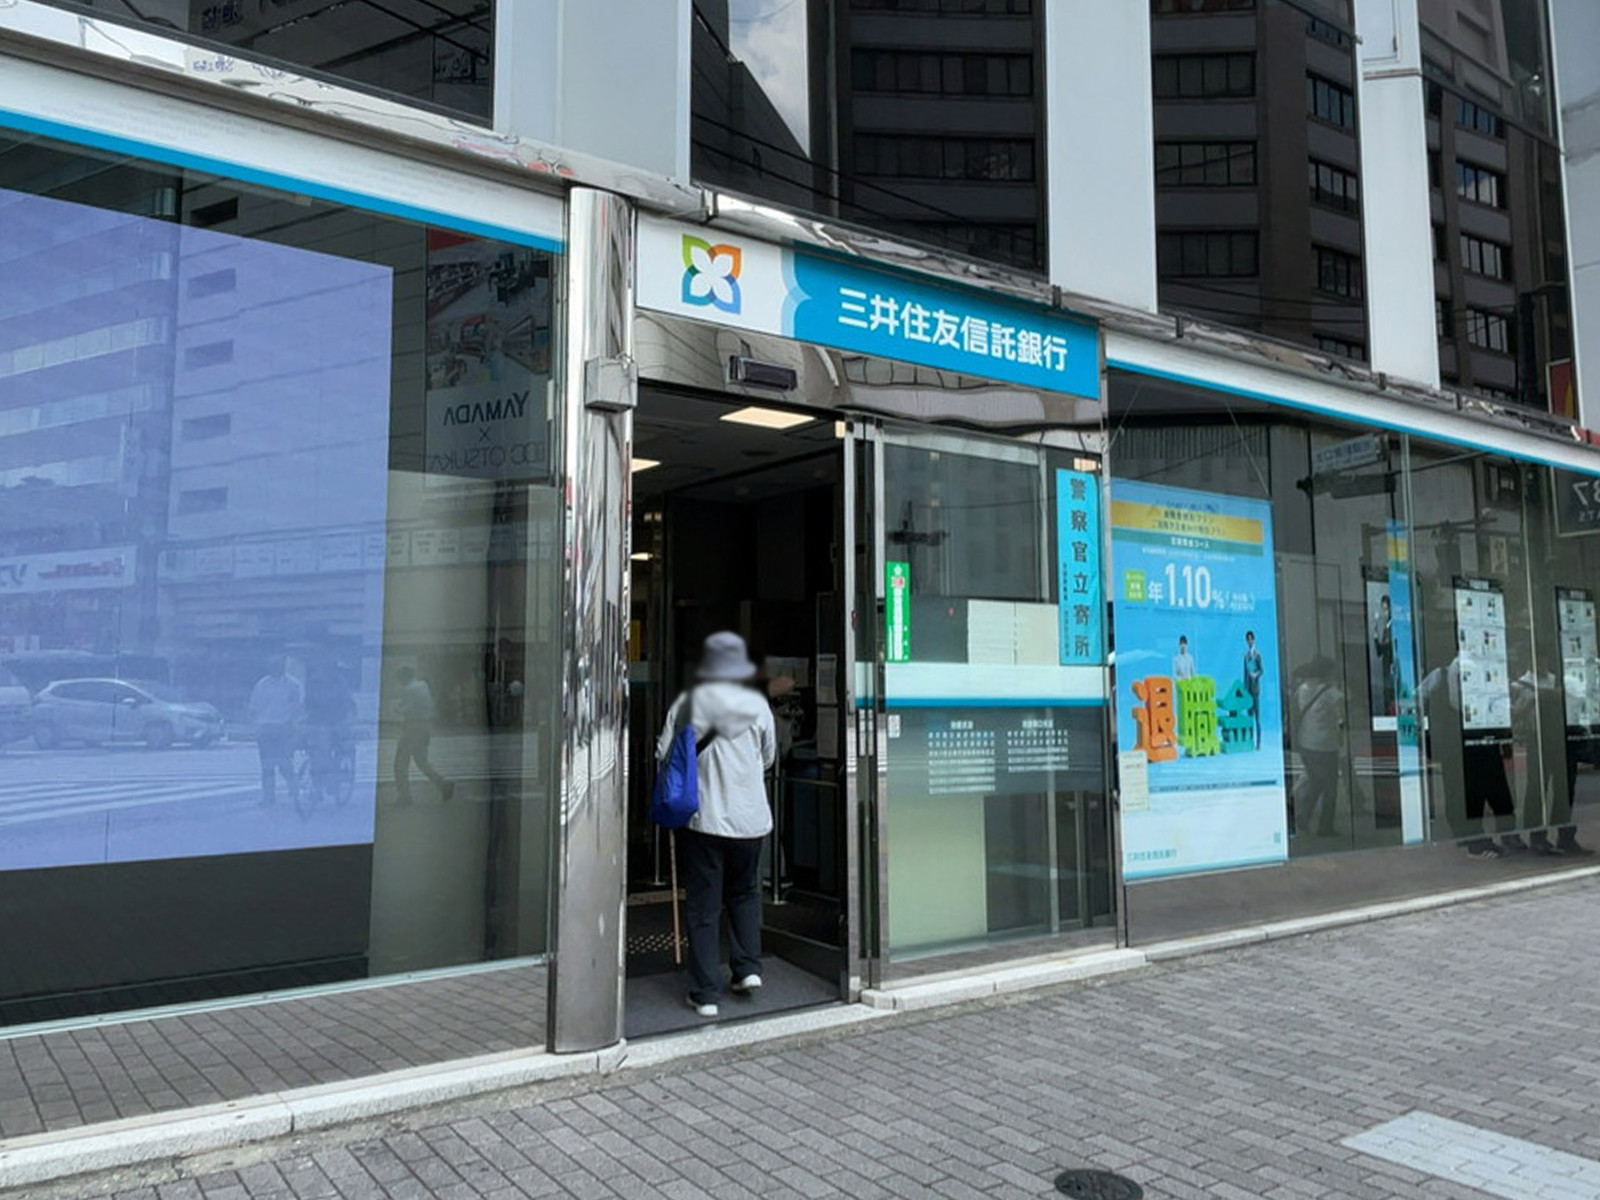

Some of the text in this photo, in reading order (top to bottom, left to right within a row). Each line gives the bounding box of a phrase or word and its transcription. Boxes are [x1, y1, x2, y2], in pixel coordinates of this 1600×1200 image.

[838, 287, 1067, 371] 三井住友信託銀行
[1070, 477, 1090, 657] 警察官立寄所
[1132, 674, 1256, 762] 退職金
